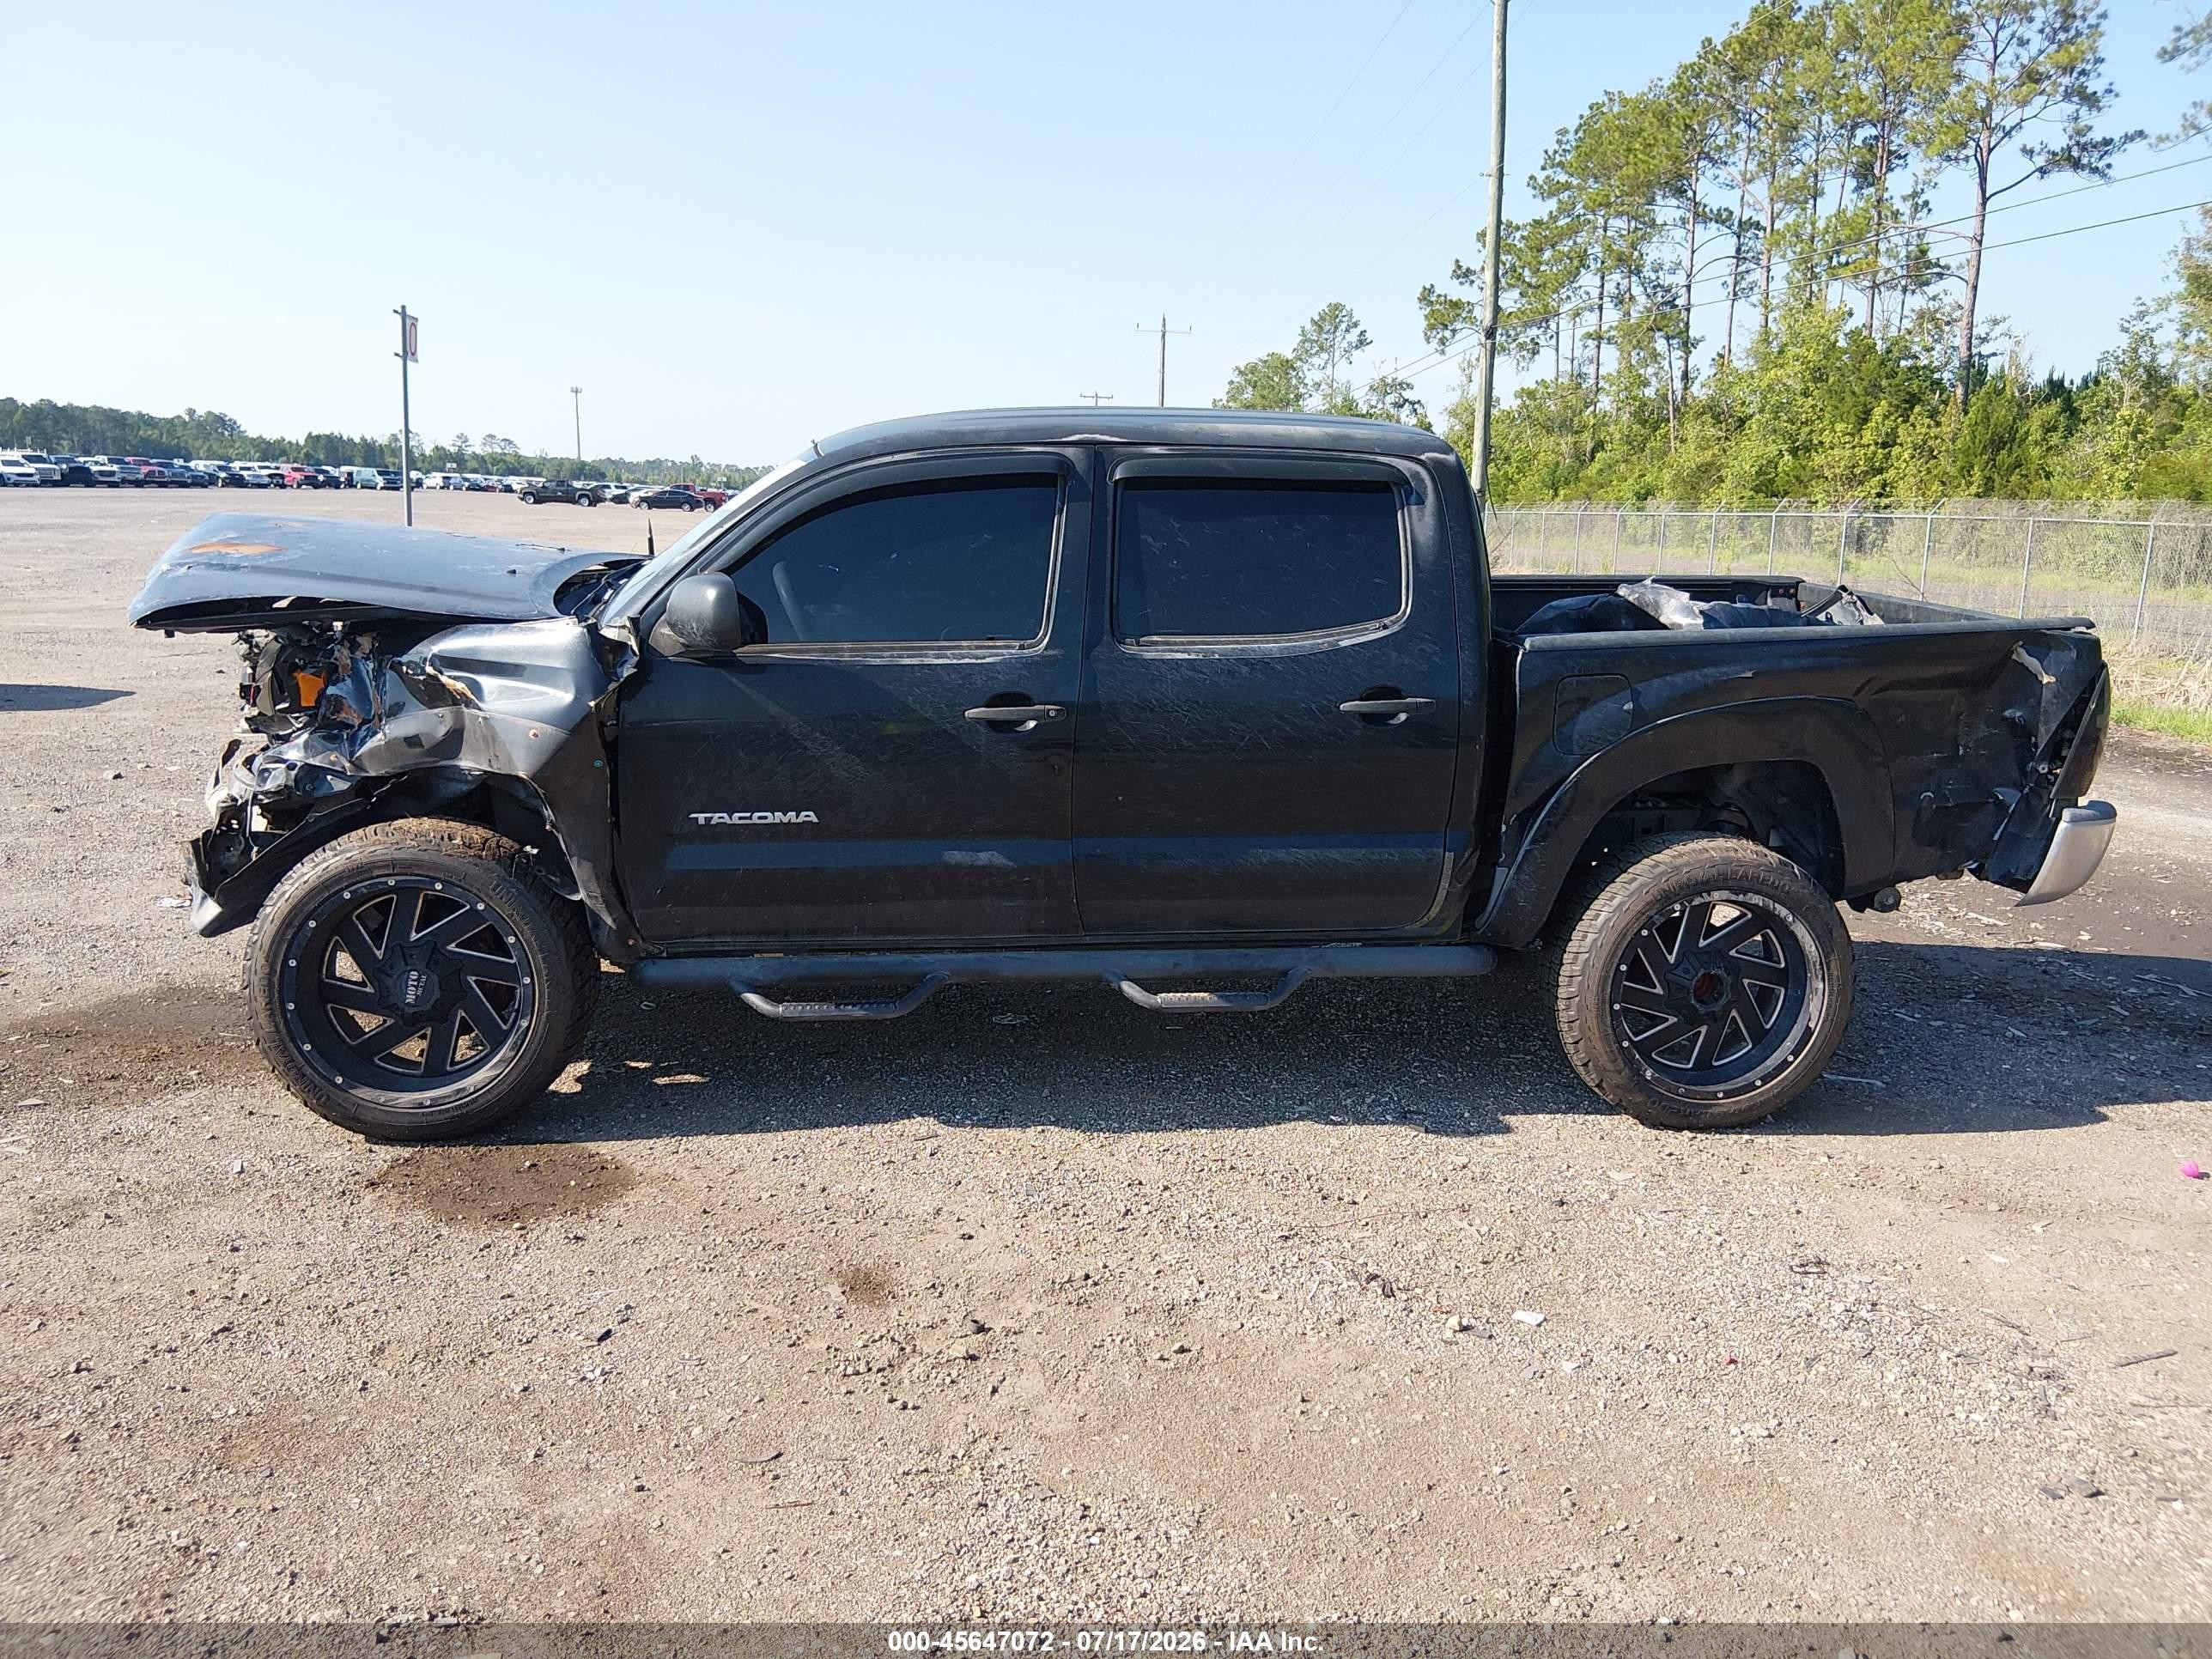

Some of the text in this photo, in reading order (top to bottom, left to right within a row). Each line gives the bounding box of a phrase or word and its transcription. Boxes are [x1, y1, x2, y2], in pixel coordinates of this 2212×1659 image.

[688, 811, 819, 825] TACOMA
[404, 970, 419, 1004] MOTO
[416, 974, 428, 997] METAL
